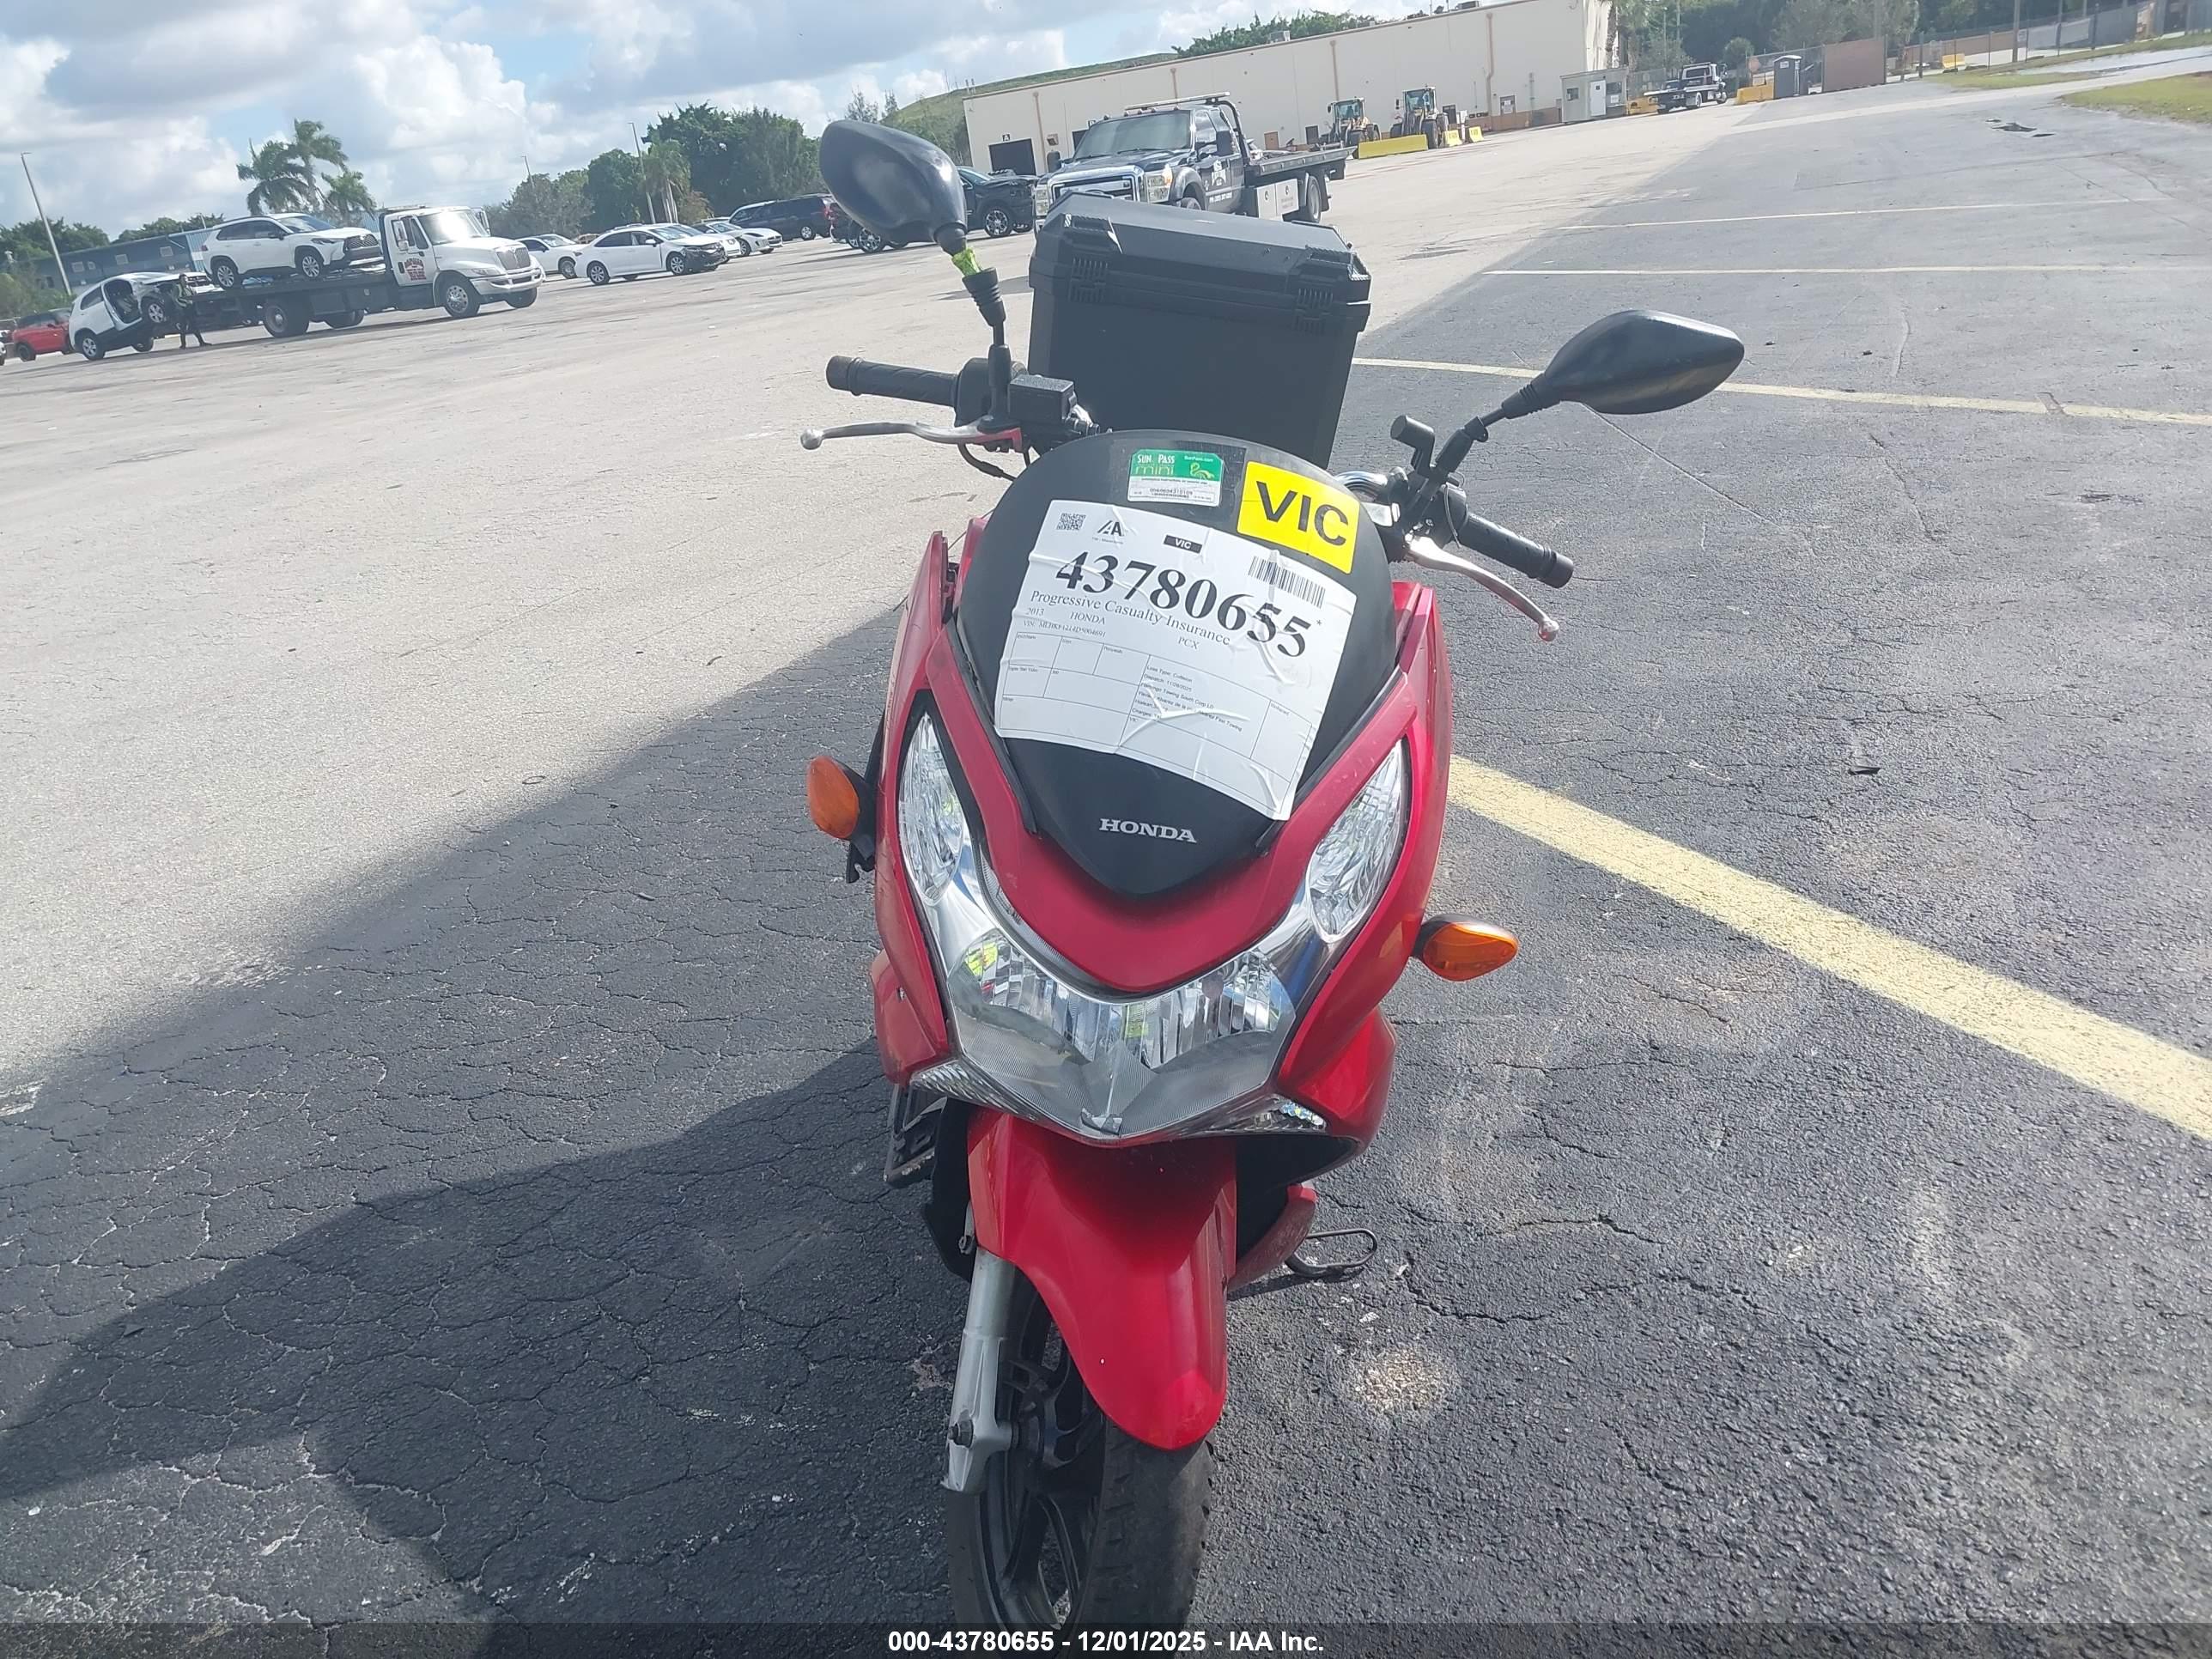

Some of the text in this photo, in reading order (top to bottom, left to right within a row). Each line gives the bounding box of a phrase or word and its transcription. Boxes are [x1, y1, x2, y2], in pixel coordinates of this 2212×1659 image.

[1135, 464, 1174, 475] mini
[1137, 453, 1175, 464] SUN PASS
[1256, 480, 1349, 546] VIC
[1175, 538, 1192, 550] VIC
[1030, 590, 1231, 646] Progressive Casualty Insurance
[1055, 551, 1312, 658] 43780655
[1025, 607, 1200, 650] 2013 HONDA PCX
[1099, 817, 1197, 843] HONDA
